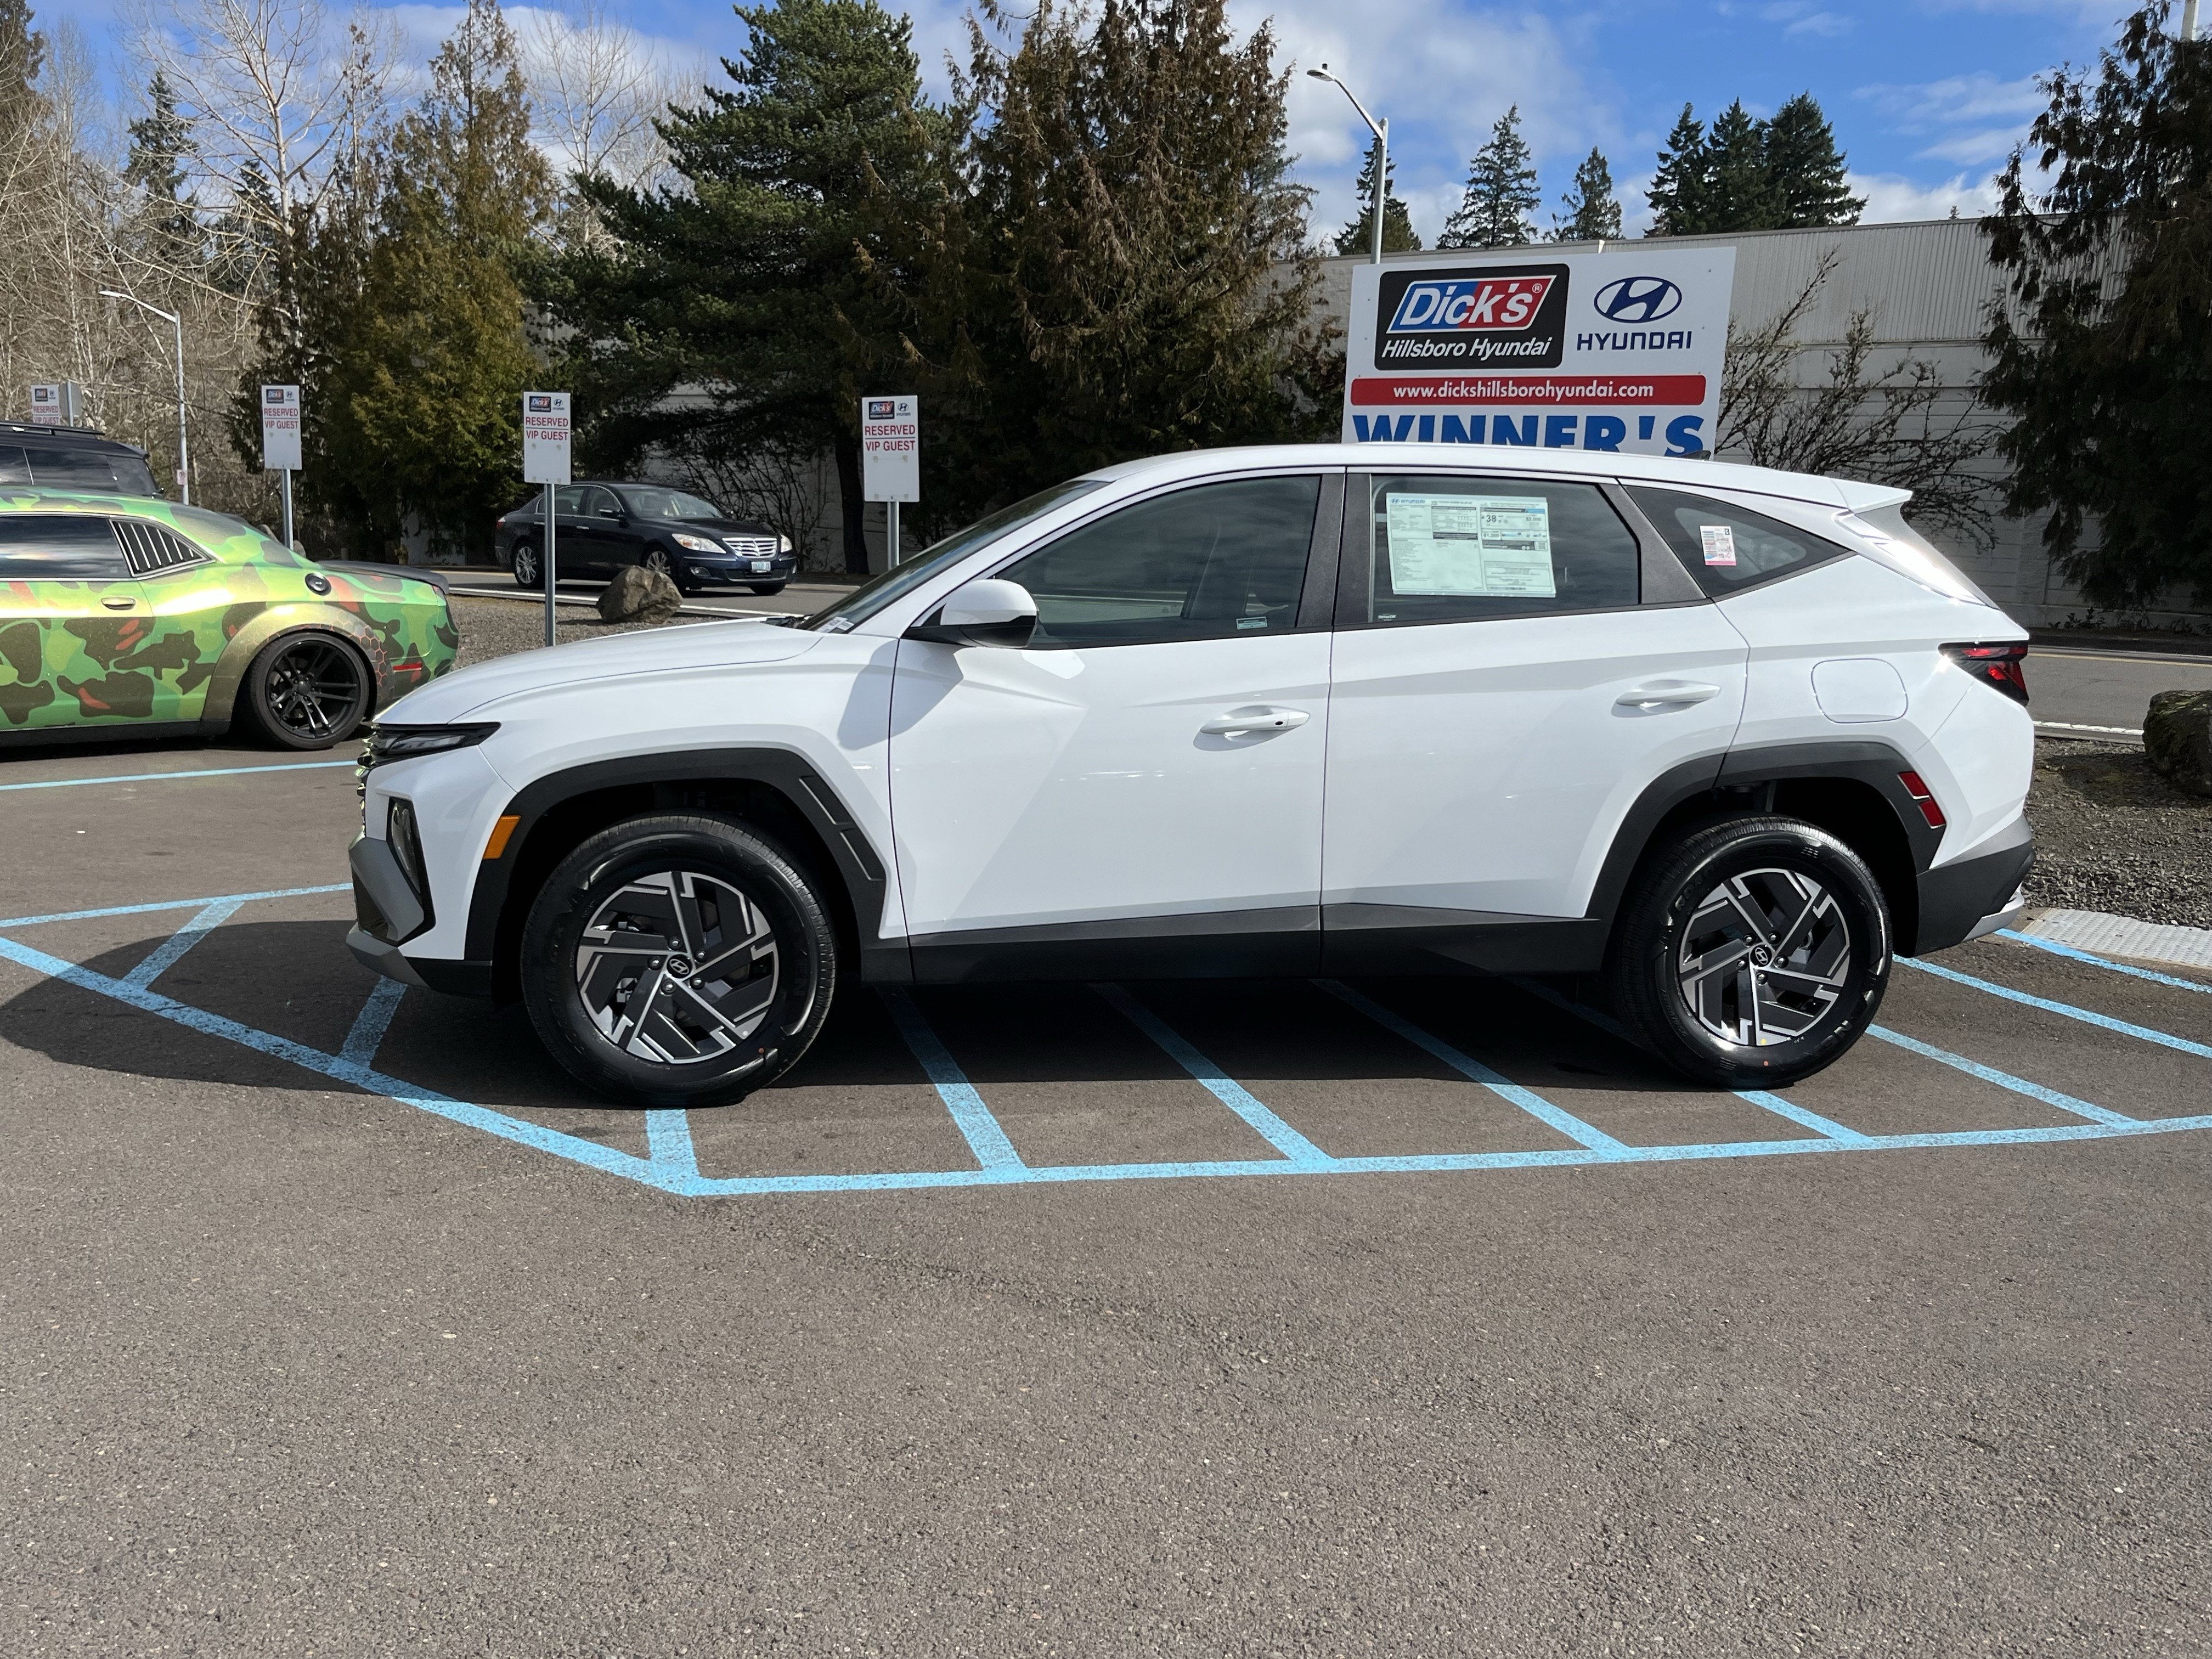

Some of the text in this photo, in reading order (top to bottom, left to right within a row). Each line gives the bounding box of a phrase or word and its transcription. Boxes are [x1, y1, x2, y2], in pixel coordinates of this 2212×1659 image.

[1400, 283, 1533, 325] Dick's
[1577, 331, 1692, 351] HYUNDAI
[1381, 336, 1553, 361] Hillsboro Hyundai
[1393, 380, 1654, 402] www.dickshillsborohyundai.com
[264, 408, 298, 416] RESERVED
[264, 420, 298, 429] VIP GUEST
[526, 417, 568, 427] RESERVED
[526, 430, 568, 441] VIP GUEST
[865, 425, 916, 436] RESERVED
[865, 440, 916, 451] VIP GUEST
